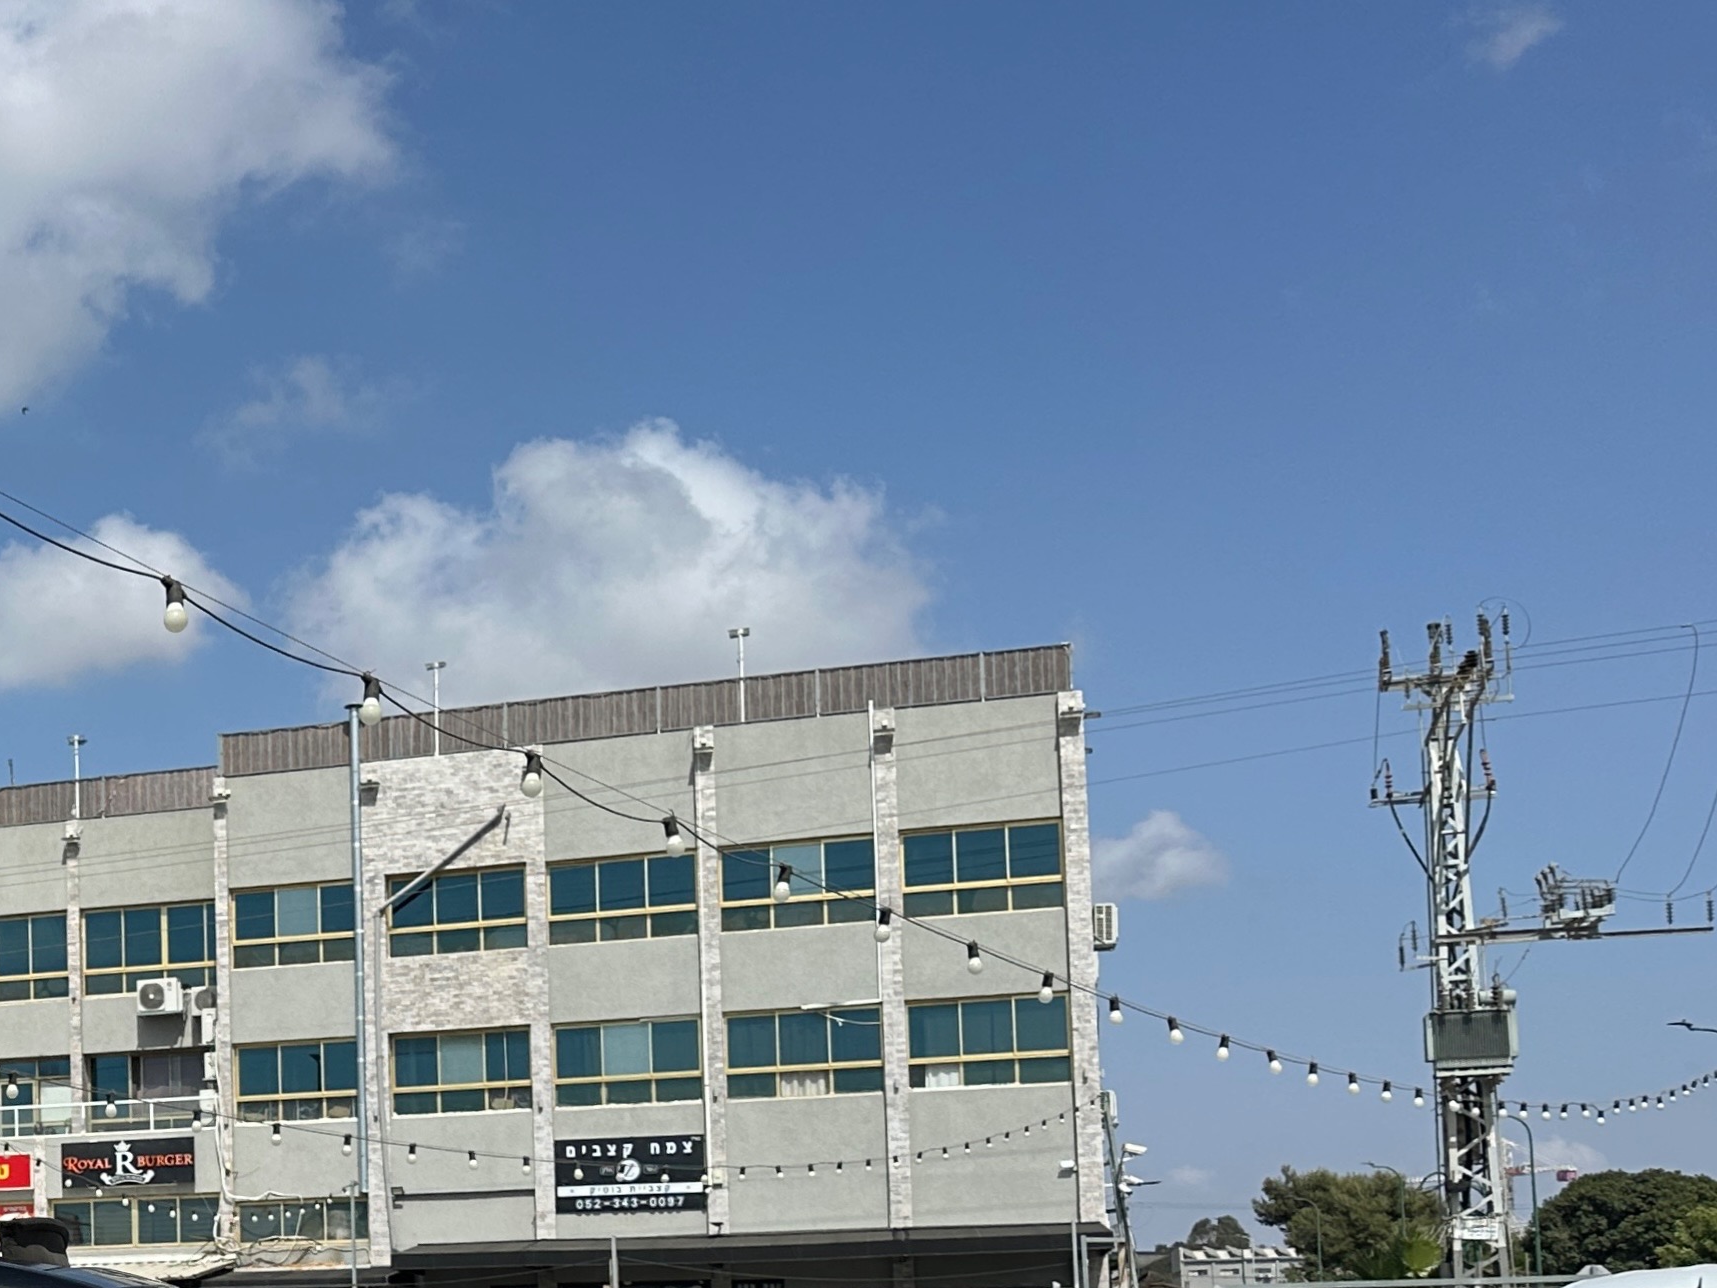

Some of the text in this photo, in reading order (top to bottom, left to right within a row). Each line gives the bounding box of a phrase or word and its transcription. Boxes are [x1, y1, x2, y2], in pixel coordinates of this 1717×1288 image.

[565, 1141, 694, 1158] צמח קצבים
[63, 1153, 194, 1174] ROYAL BURGER
[114, 1151, 144, 1175] R
